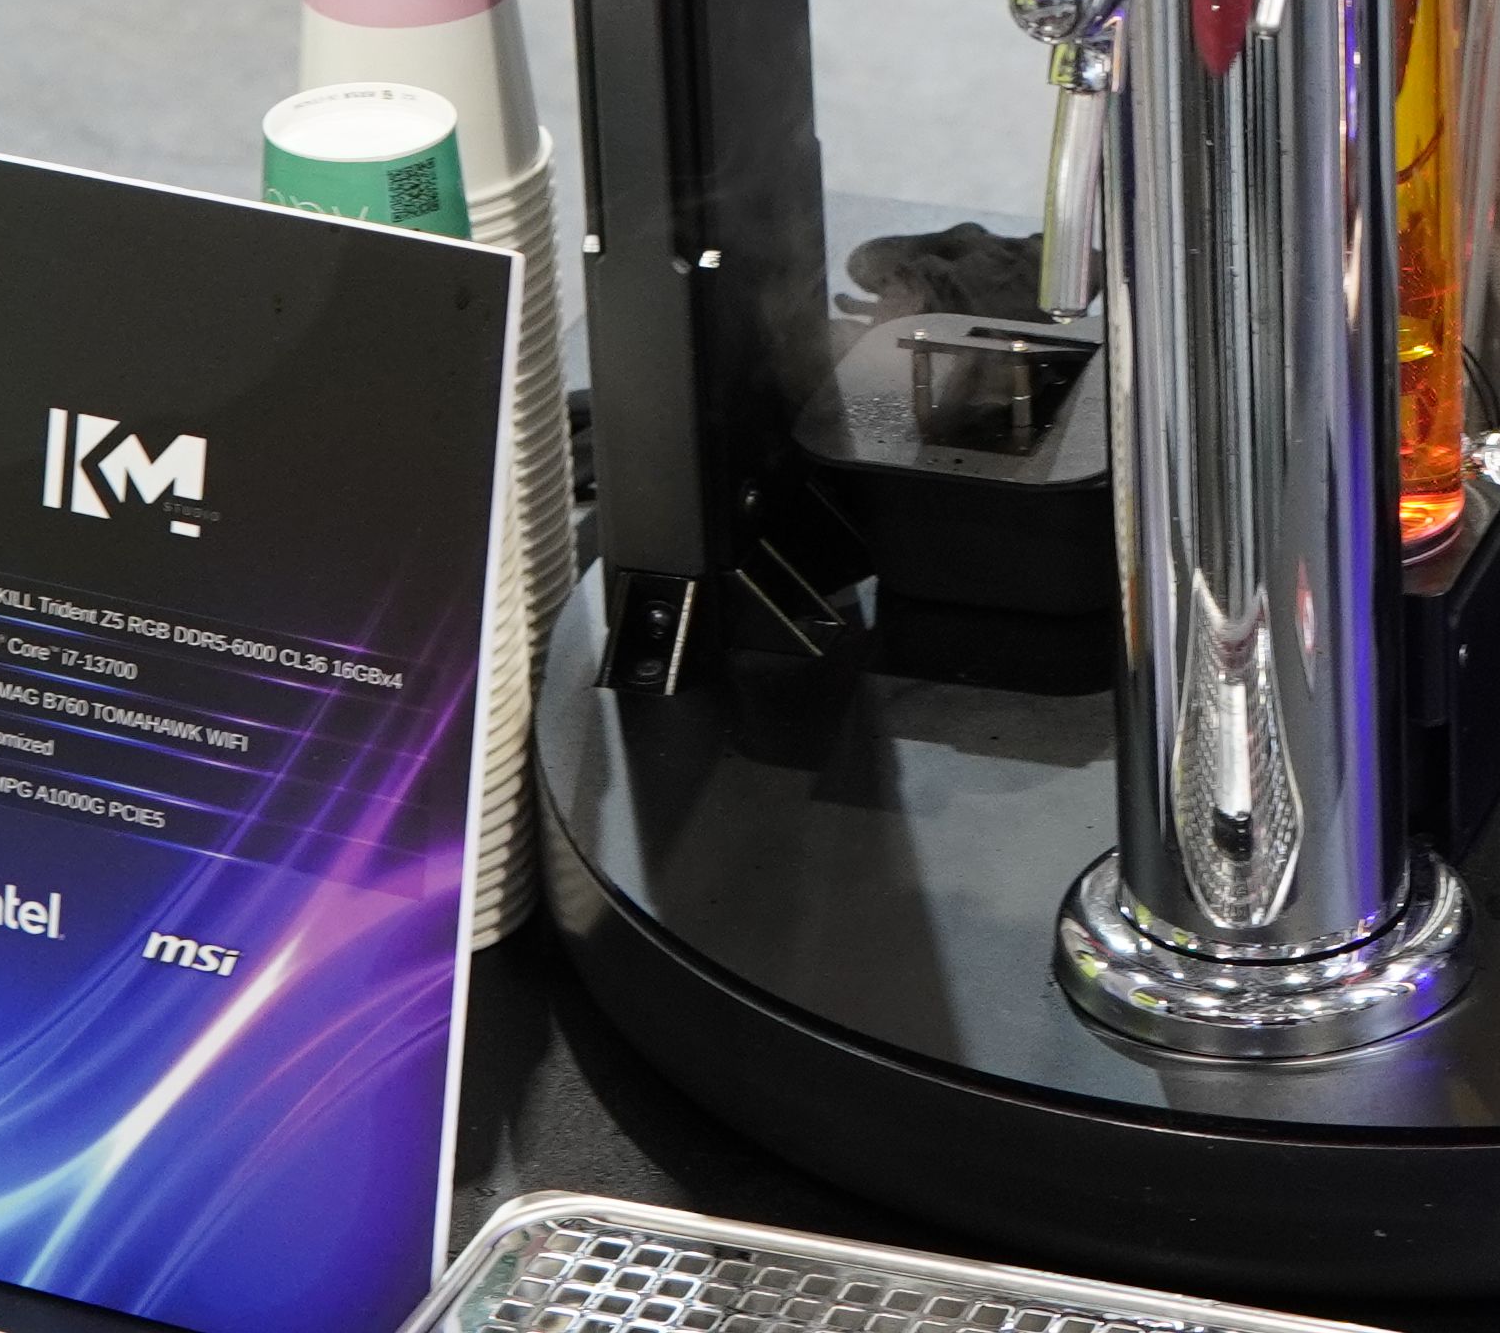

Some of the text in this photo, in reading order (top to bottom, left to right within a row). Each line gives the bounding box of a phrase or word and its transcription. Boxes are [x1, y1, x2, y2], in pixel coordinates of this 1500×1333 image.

[162, 501, 221, 522] STUDIO
[38, 596, 98, 625] Trident
[100, 609, 126, 630] Z5
[127, 615, 172, 640] RGB
[174, 624, 278, 663] DDR5-6000
[279, 648, 329, 675] CL36
[331, 659, 404, 690] 16GBx4
[61, 648, 139, 681] i7-13700
[42, 691, 90, 718] B760
[92, 702, 204, 744] TOMAHAWK
[206, 727, 250, 752] WIFI
[34, 785, 106, 816] A1000G
[108, 800, 166, 829] PCIE5
[142, 931, 242, 978] msi
